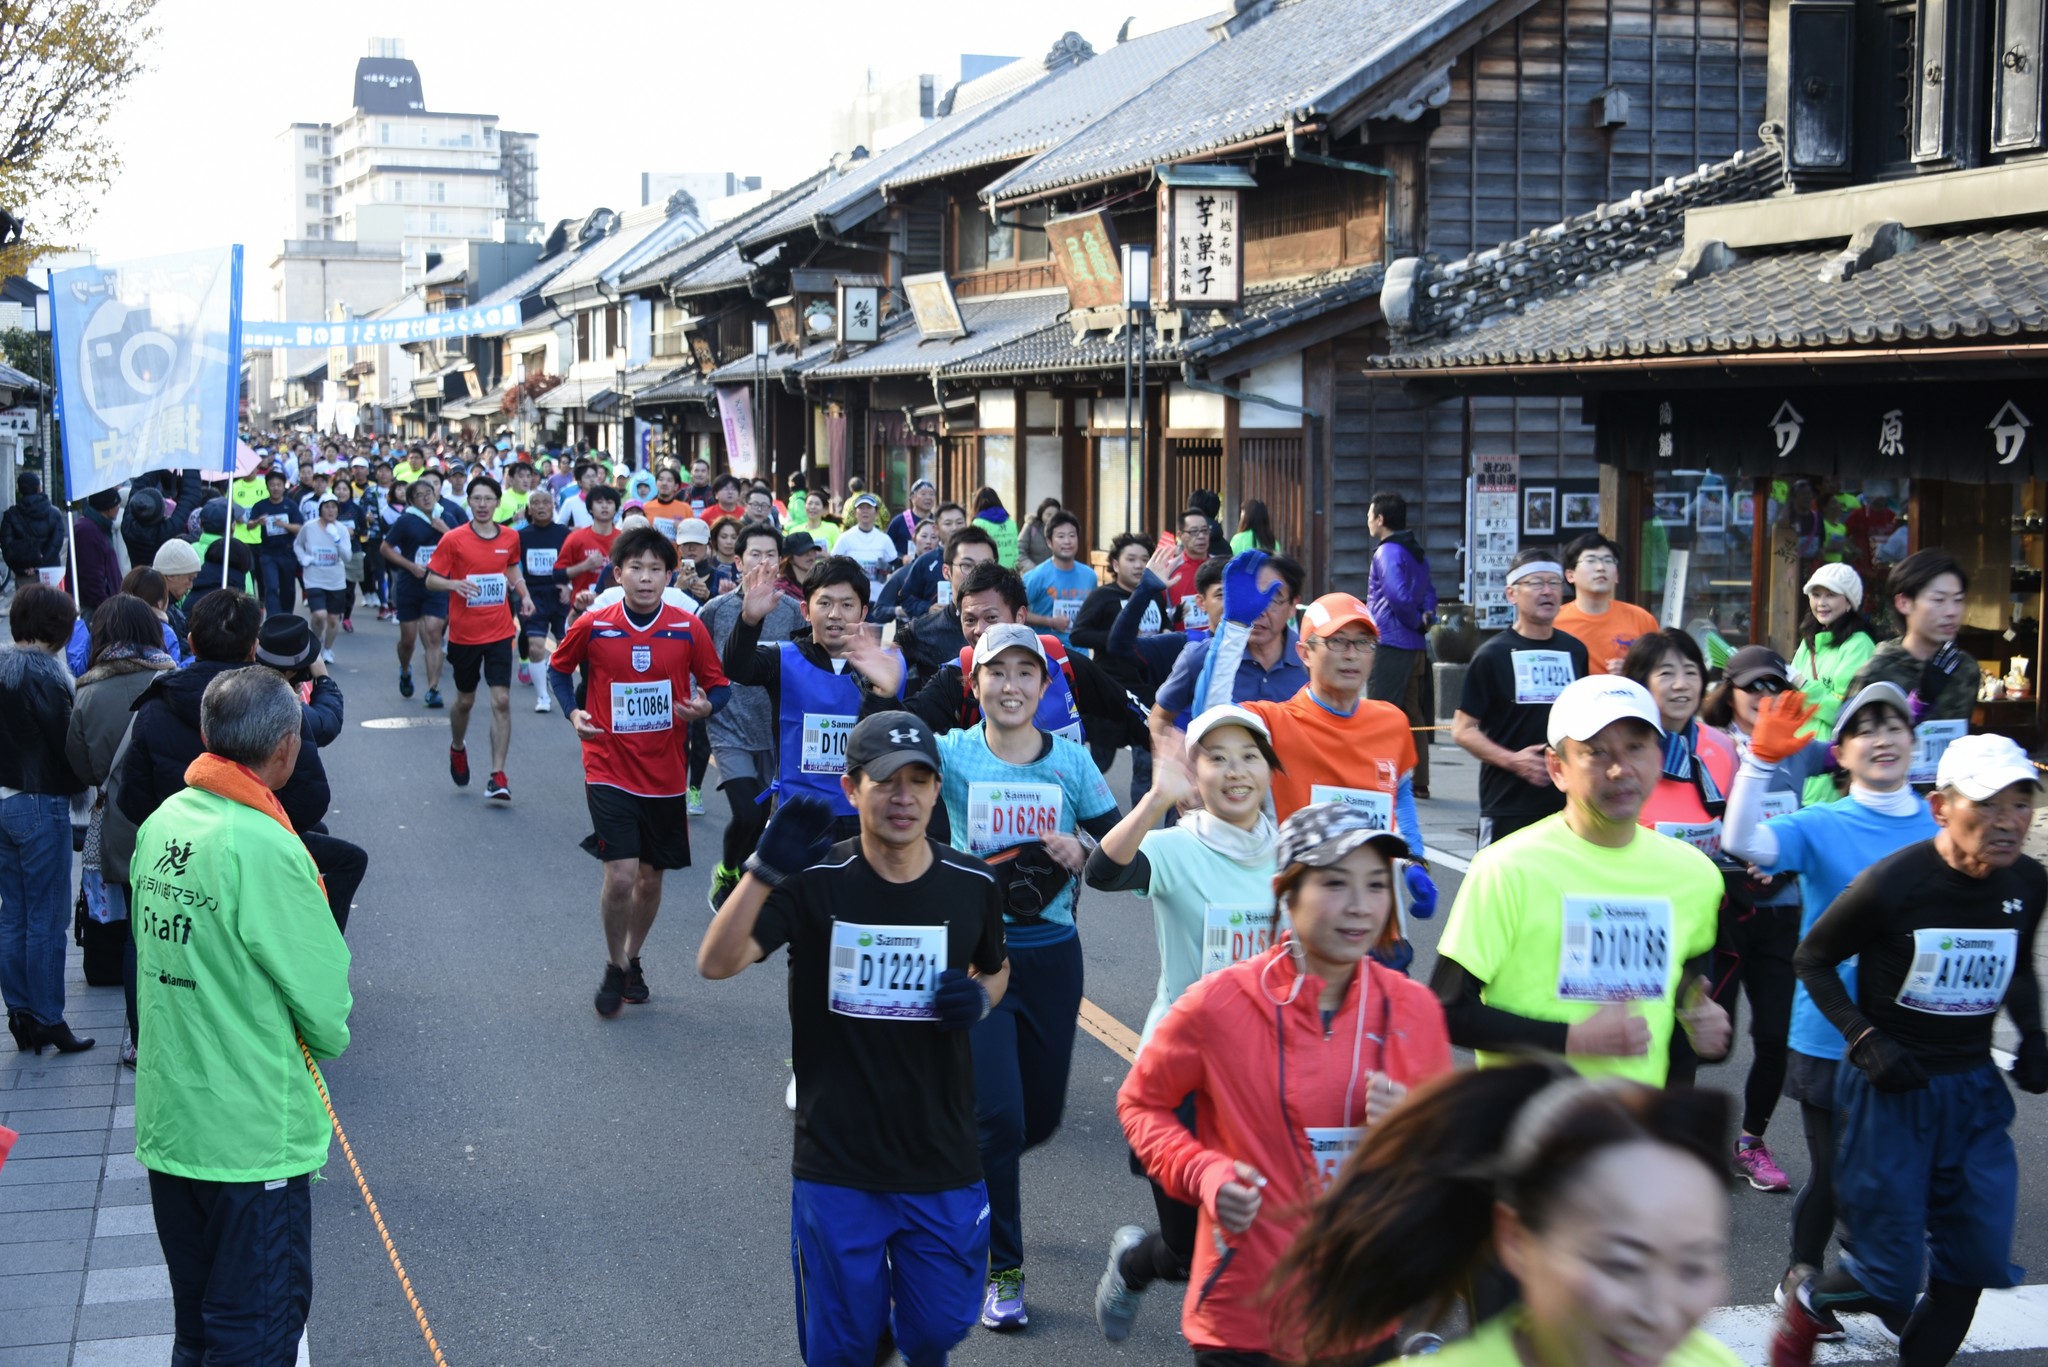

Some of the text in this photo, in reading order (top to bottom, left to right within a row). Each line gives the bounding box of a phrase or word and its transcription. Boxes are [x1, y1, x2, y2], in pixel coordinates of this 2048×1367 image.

[1195, 195, 1217, 295] 芋菓子
[1878, 408, 1905, 457] 原
[634, 686, 660, 695] Sammy
[627, 695, 670, 717] C10864
[831, 719, 857, 729] Samm
[1004, 788, 1041, 804] Sammy
[993, 804, 1058, 837] D16266
[143, 905, 193, 945] Staff
[875, 933, 923, 949] Sammy
[1953, 936, 1997, 951] Sammy
[859, 951, 938, 992] D12221
[167, 973, 198, 991] Sammy
[1306, 1137, 1358, 1152] Samm
